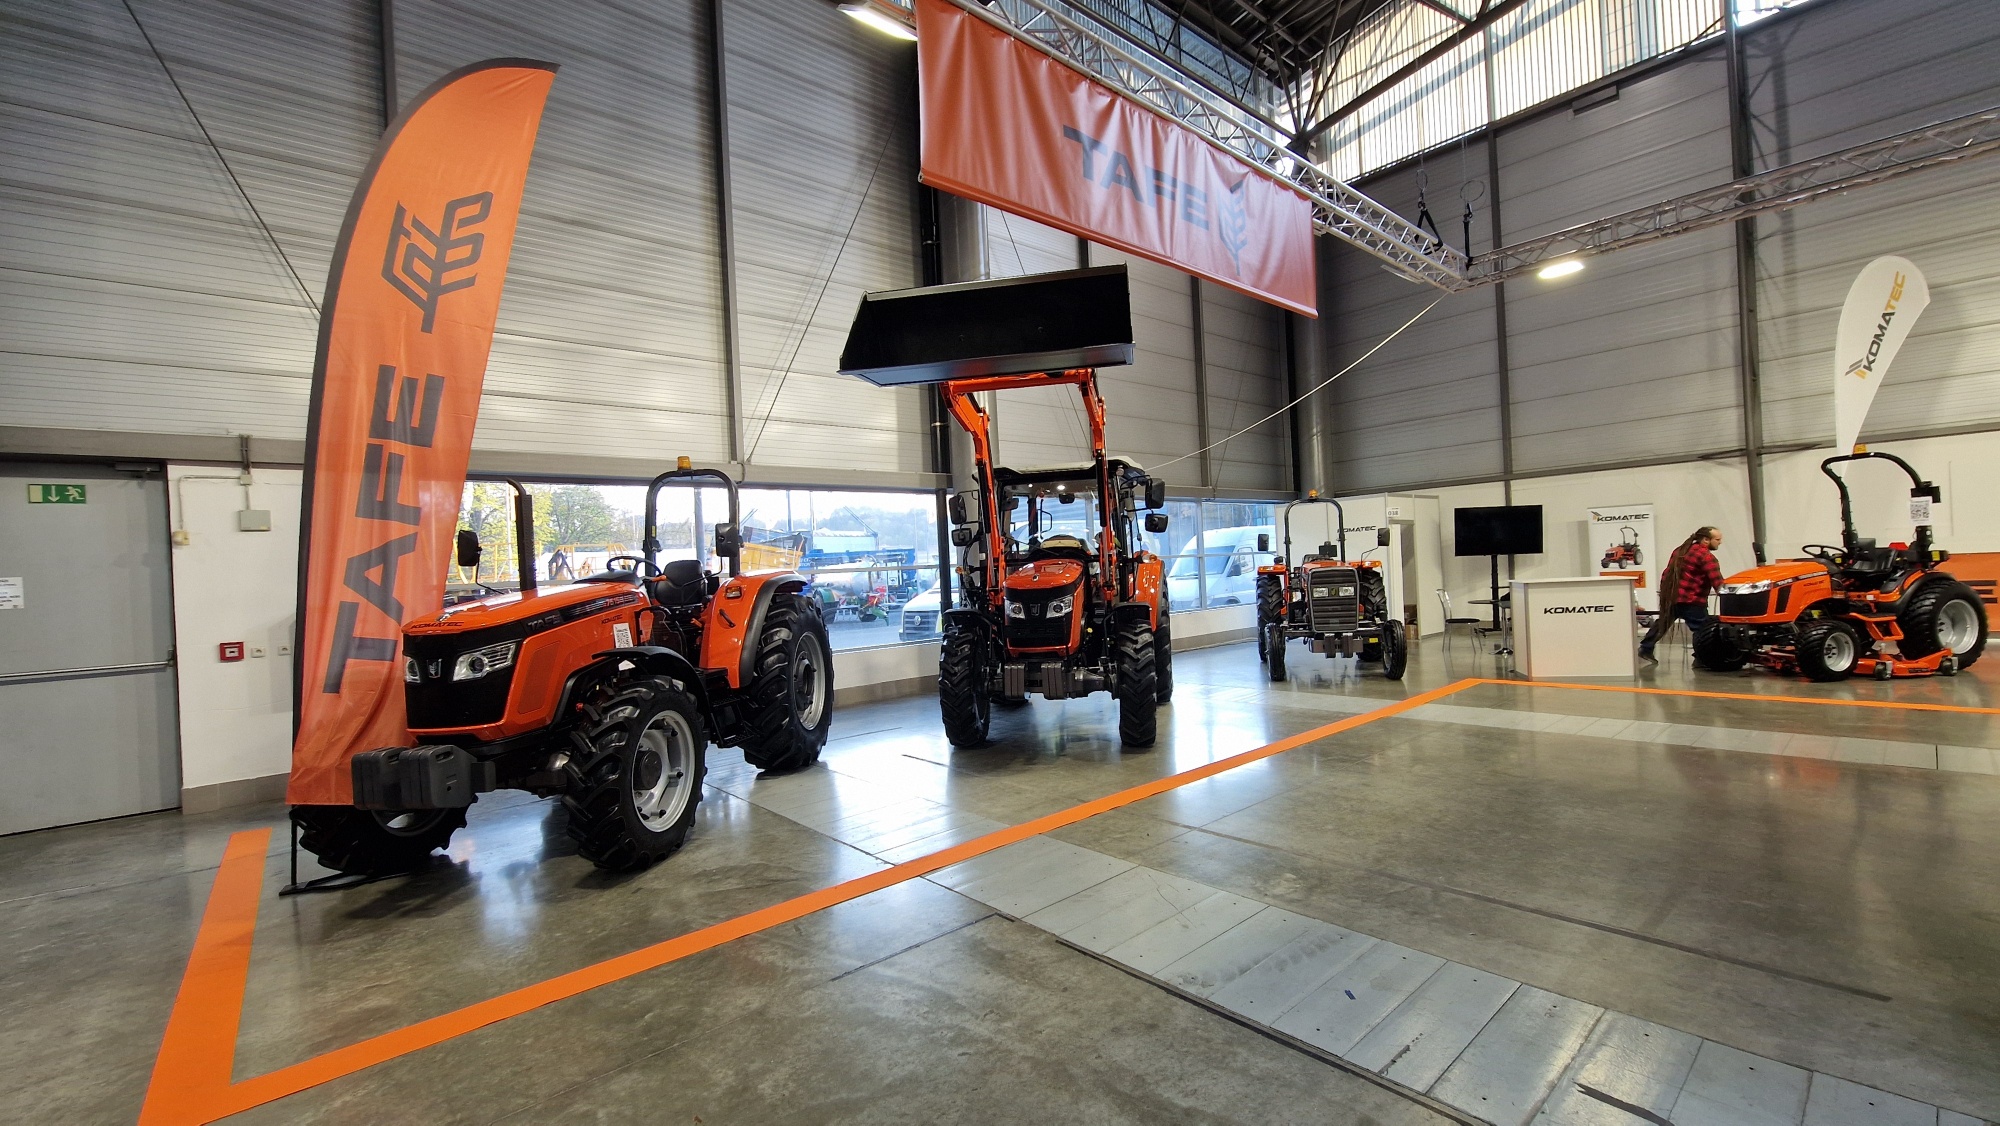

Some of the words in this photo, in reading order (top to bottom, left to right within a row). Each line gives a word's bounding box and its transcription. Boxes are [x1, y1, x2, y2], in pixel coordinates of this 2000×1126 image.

[1063, 124, 1209, 231] TAFE
[1863, 271, 1905, 372] KOMATEC
[1597, 513, 1650, 522] KOMATEC
[322, 364, 446, 694] TAFE
[1544, 605, 1615, 615] KOMATEC
[411, 621, 465, 629] KOMATEC
[527, 614, 561, 630] TAFE
